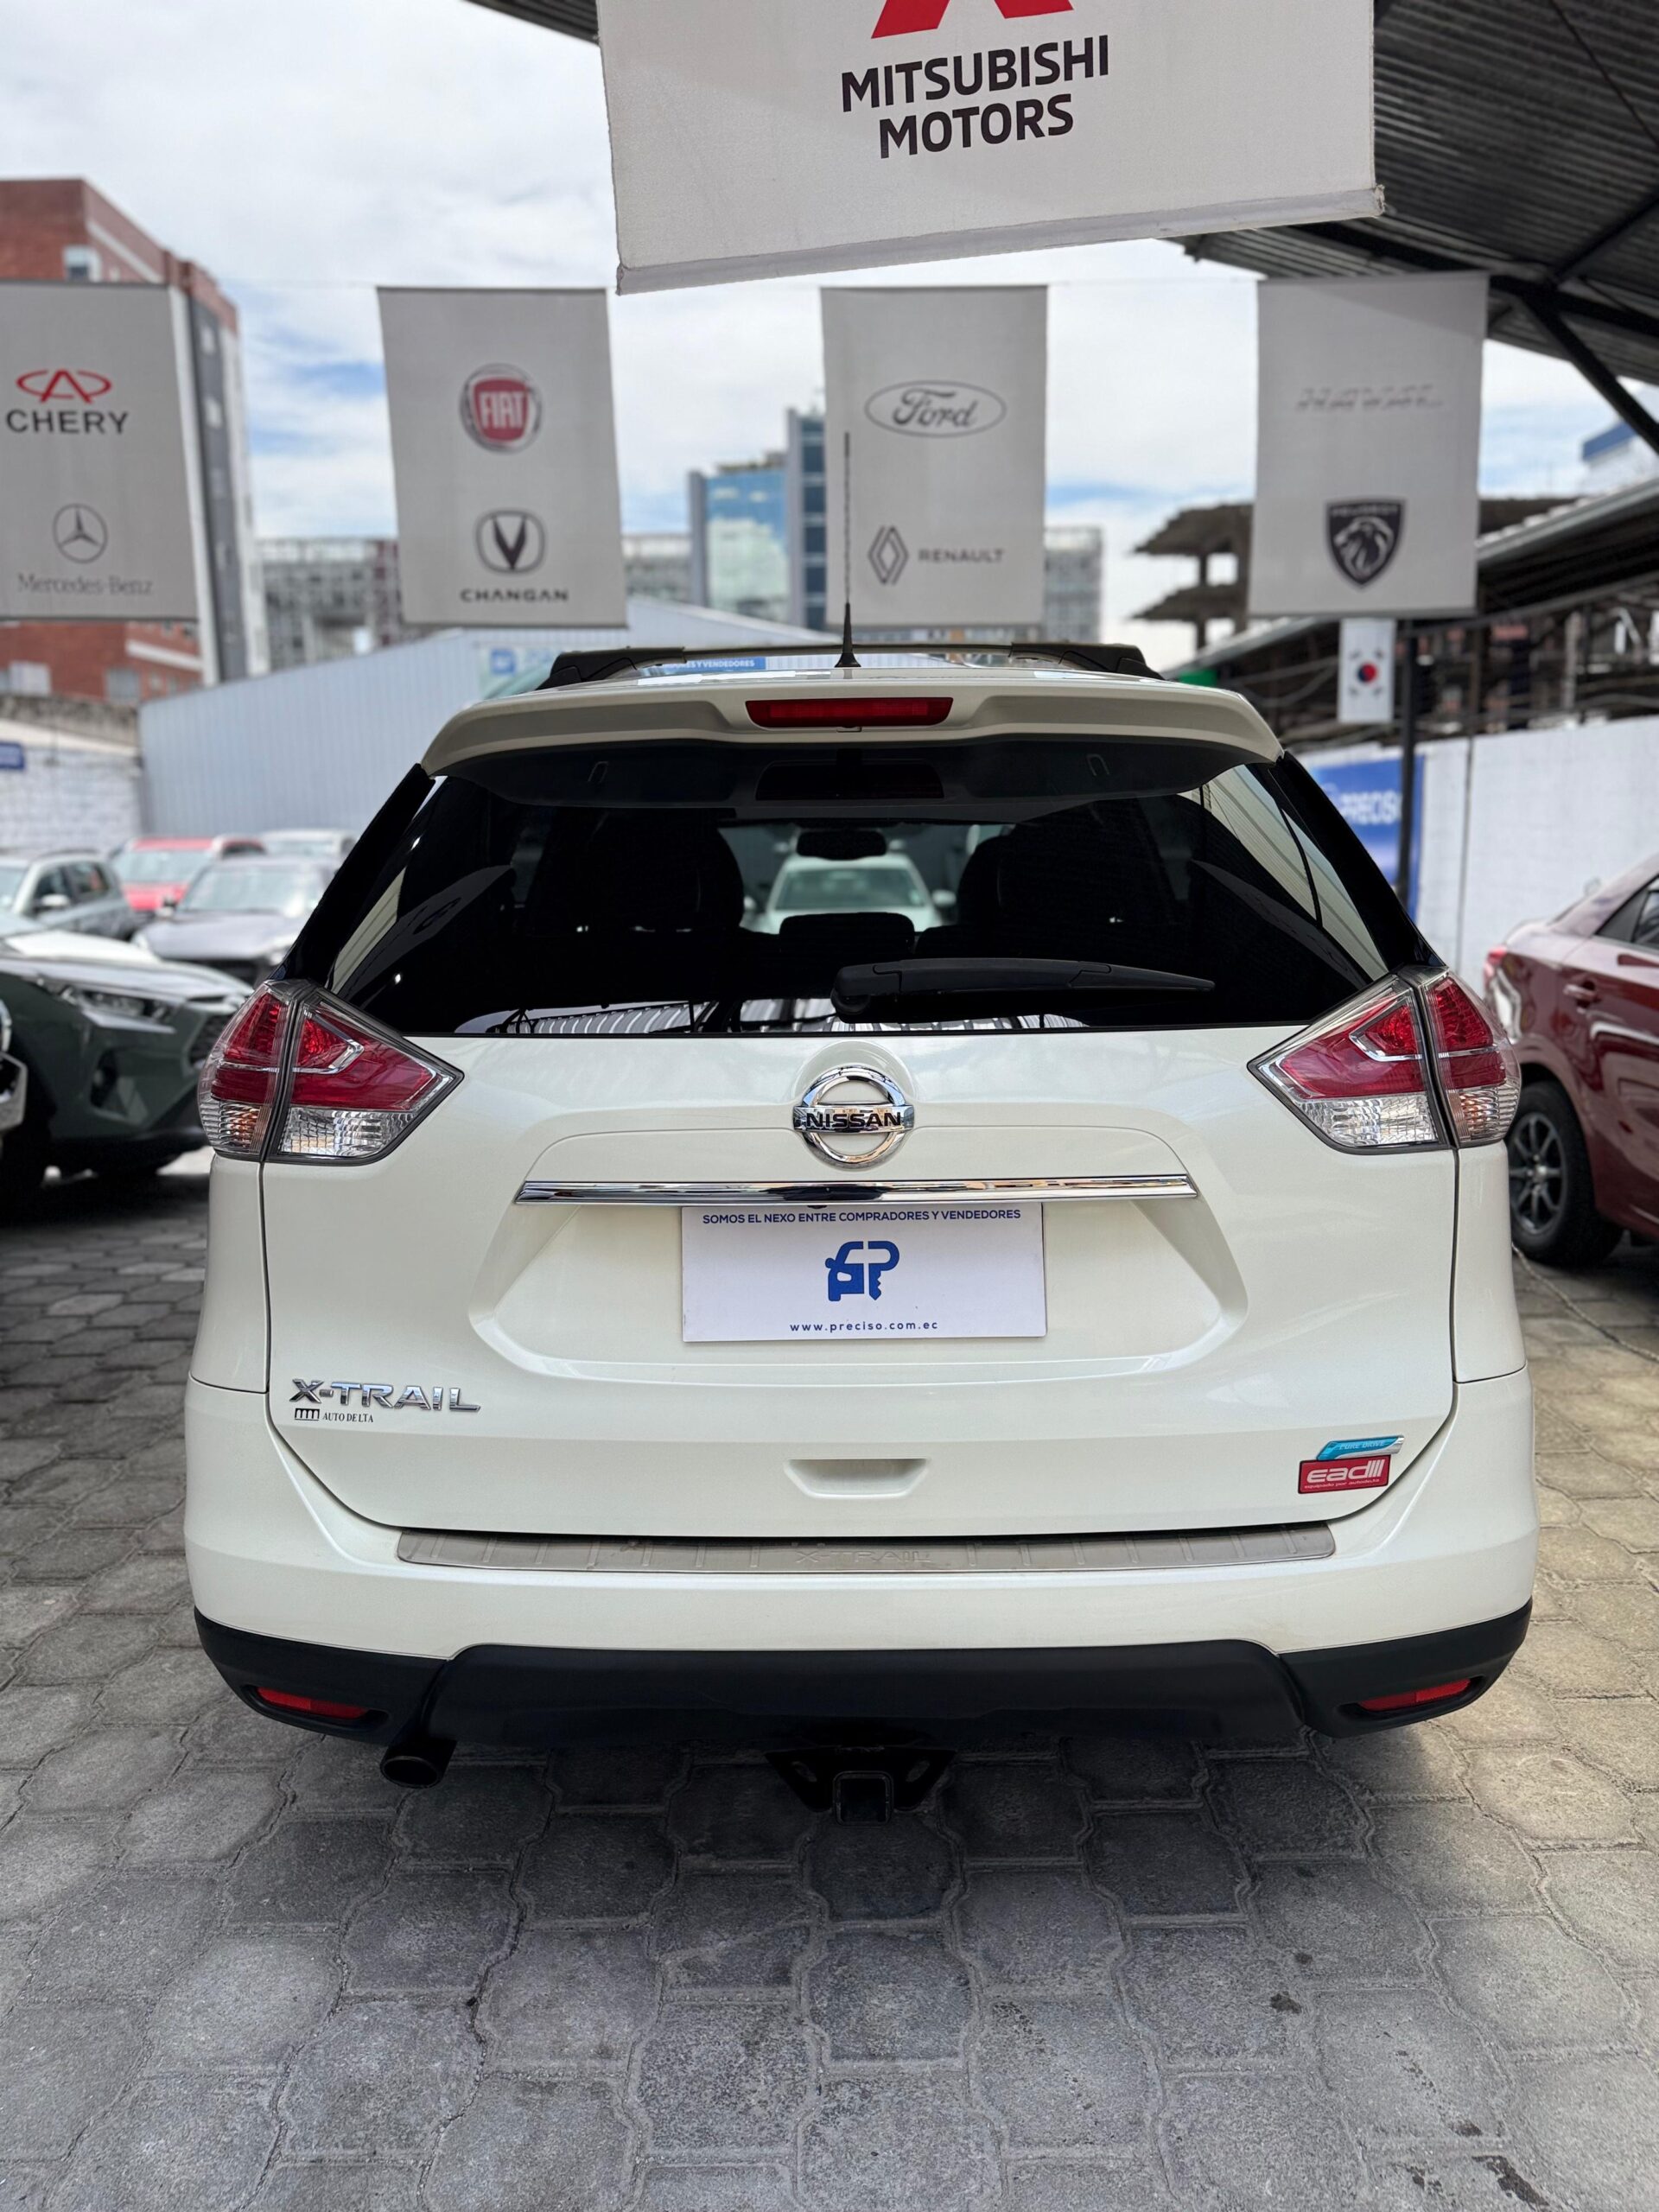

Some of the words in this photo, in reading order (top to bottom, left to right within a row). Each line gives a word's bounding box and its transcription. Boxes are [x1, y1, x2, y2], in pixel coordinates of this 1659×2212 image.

[841, 35, 1109, 112] MITSUBISHI
[879, 93, 1074, 159] MOTORS
[479, 391, 525, 429] FIAT
[892, 387, 979, 428] Ford
[5, 409, 129, 435] CHERY
[918, 548, 1004, 563] RENAULT
[460, 588, 569, 603] CHANGAN
[702, 659, 755, 668] VENDEDORES
[805, 1111, 901, 1128] NISSAN
[702, 1214, 745, 1224] SOMOS
[747, 1213, 762, 1224] EL
[764, 1212, 796, 1224] NEXO
[798, 1211, 836, 1223] ENTRE
[839, 1211, 930, 1223] COMPRADORES
[931, 1211, 940, 1220] Y
[941, 1209, 1021, 1221] VENDEDORES
[790, 1320, 938, 1333] www.preciso.com.ec
[289, 1377, 481, 1413] X-TRAIL
[322, 1412, 346, 1422] AUTO
[346, 1413, 374, 1423] DELTA
[794, 1550, 933, 1563] X-TRAIL
